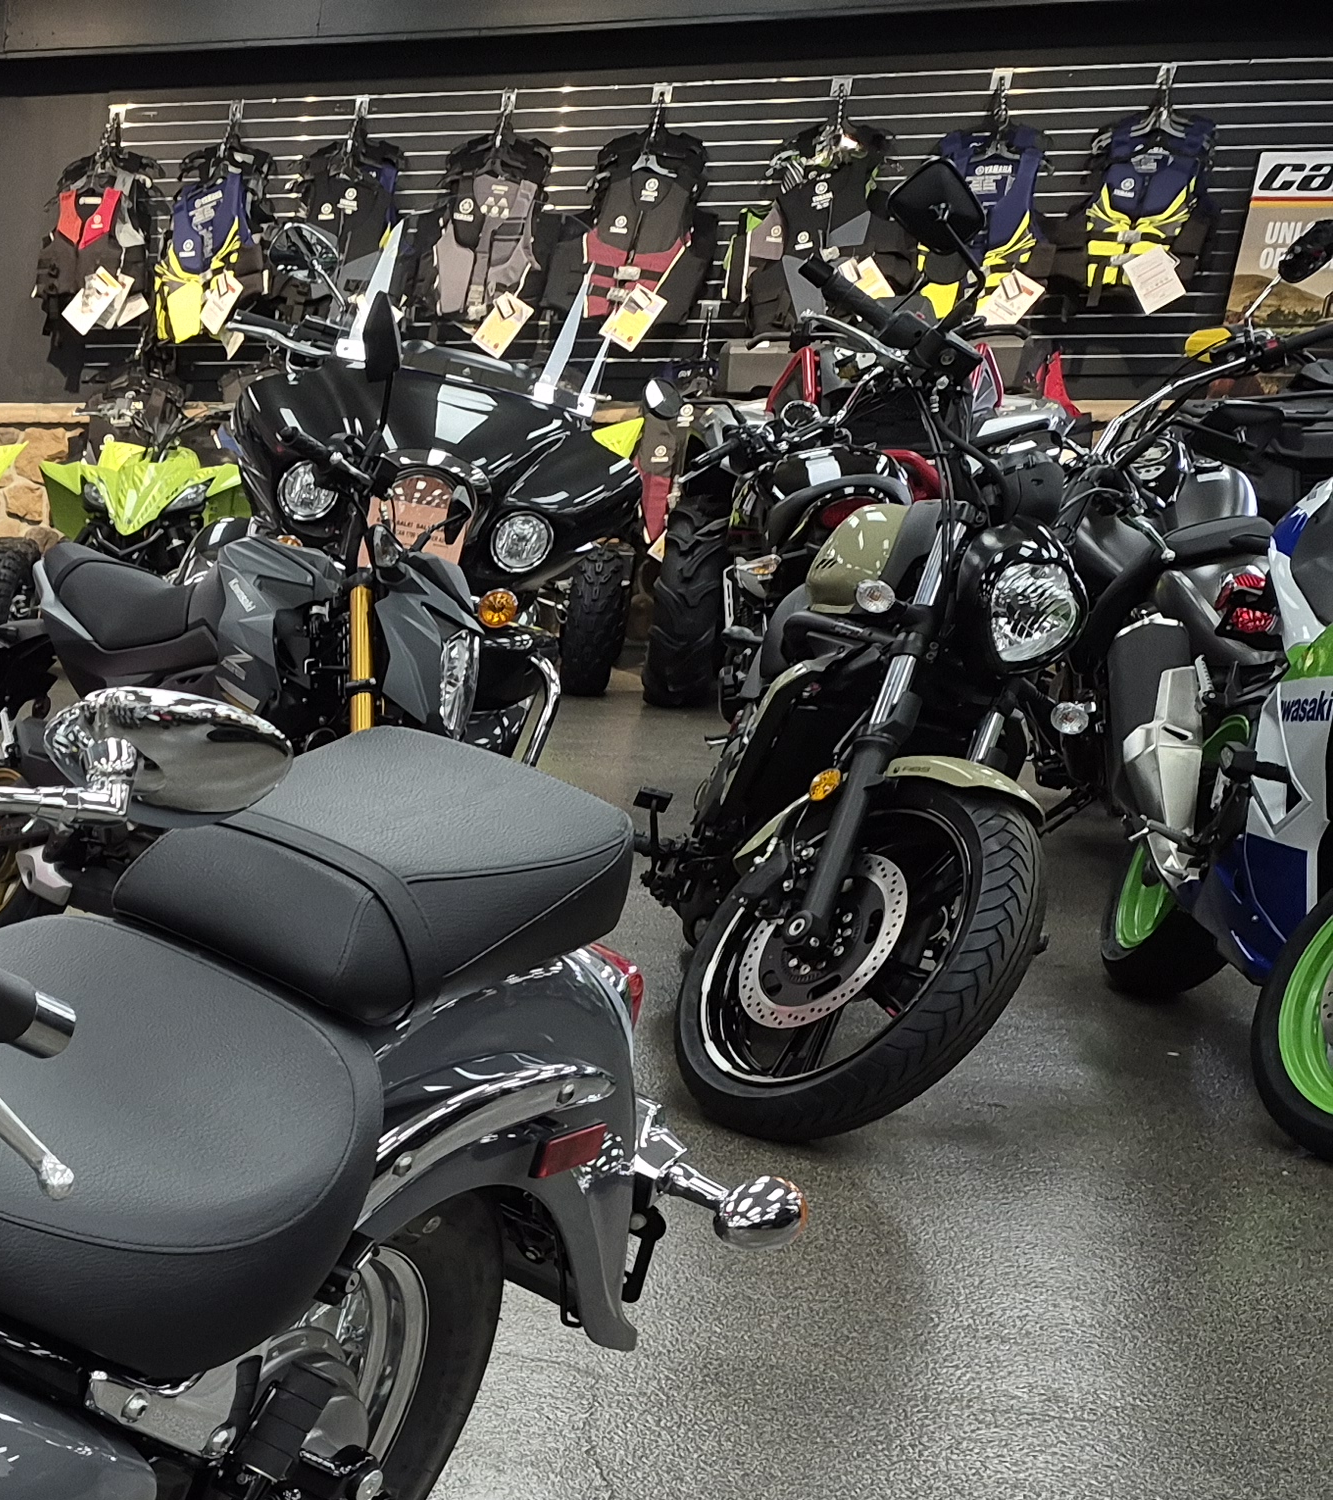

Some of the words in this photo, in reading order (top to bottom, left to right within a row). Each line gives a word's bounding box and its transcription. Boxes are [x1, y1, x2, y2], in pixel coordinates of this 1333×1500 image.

[985, 165, 1013, 174] YAMAHA
[228, 577, 256, 613] Kawasaki
[1281, 690, 1333, 722] wasaki
